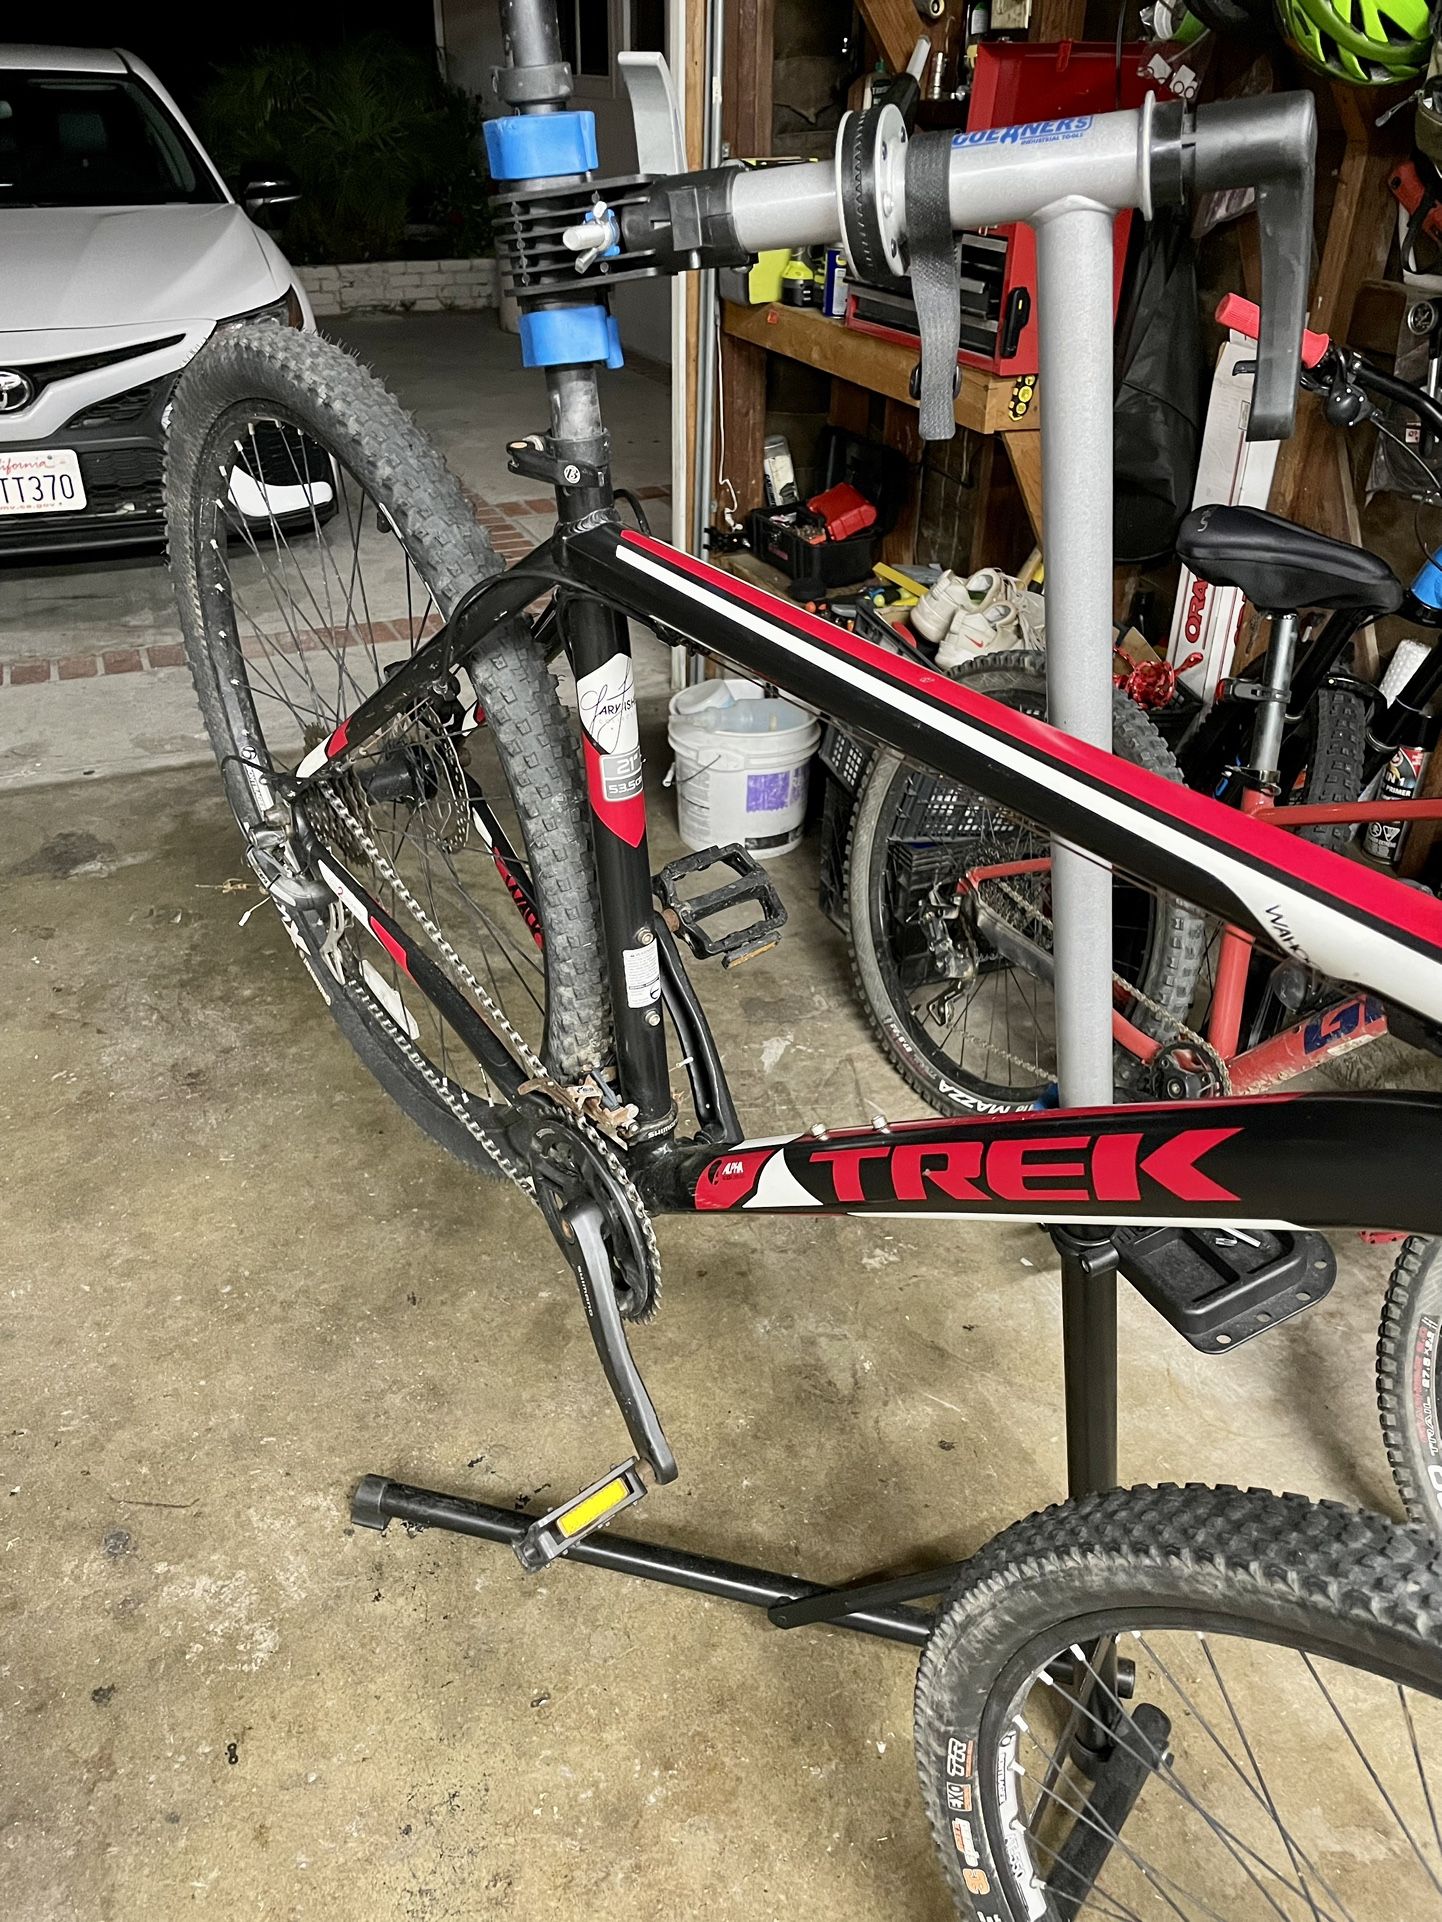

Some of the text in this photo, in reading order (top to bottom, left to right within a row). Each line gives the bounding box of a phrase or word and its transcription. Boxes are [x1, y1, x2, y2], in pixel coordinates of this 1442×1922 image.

[1021, 132, 1084, 146] INDUSTRIAL TOOLS
[938, 1078, 1011, 1115] MAZZA
[809, 1127, 1245, 1202] TREK
[1424, 1397, 1439, 1457] TRAIL
[948, 1783, 965, 1811] EXO
